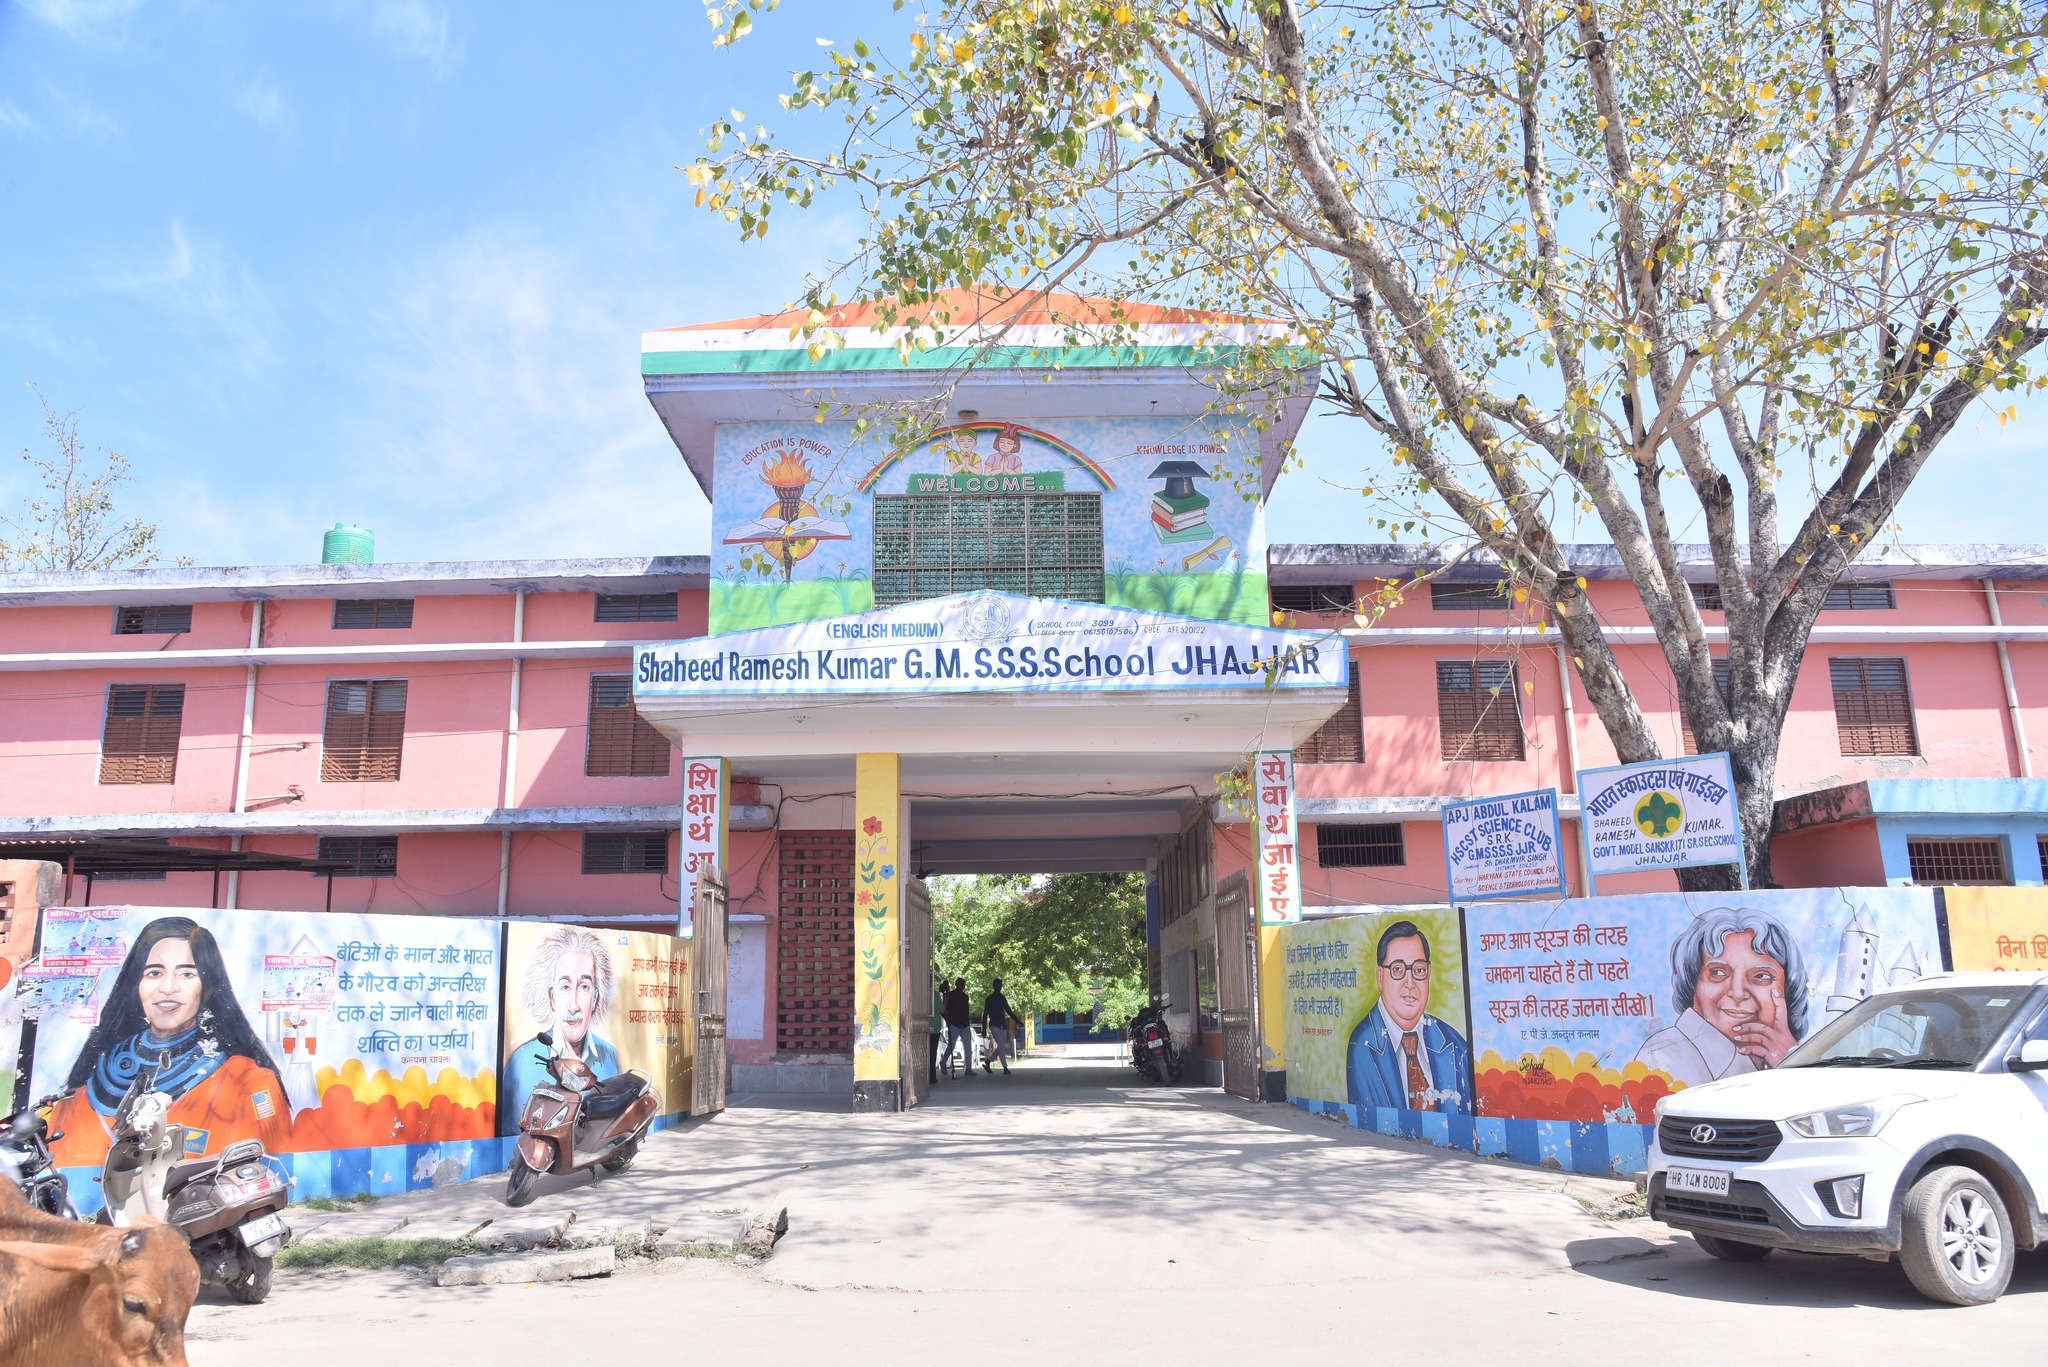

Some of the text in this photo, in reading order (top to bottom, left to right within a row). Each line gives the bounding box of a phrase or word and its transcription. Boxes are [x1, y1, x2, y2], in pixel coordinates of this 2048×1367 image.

[741, 437, 832, 465] EDUCATION IS POWER
[1136, 444, 1186, 455] KNOWLEDGE
[1188, 444, 1196, 454] IS
[826, 618, 945, 641] (ENGLISH MEDIUM)
[638, 650, 724, 684] Shaheed
[729, 650, 810, 681] Ramesh
[818, 649, 898, 680] Kumar
[1171, 643, 1321, 676] JHAJJAR
[1586, 784, 1621, 817] भारत
[1615, 769, 1668, 798] स्काउट्स
[1668, 768, 1686, 790] एवं
[1447, 795, 1552, 825] APJ ABDUL KALAM
[1593, 816, 1632, 829] SHAHEED
[1450, 817, 1552, 866] HSCST SCIENCE CLUB
[1595, 829, 1637, 843] RAMESH
[1494, 855, 1526, 866] DHARMVIR
[1528, 852, 1548, 863] SINGH
[1593, 845, 1619, 859] GOVT.
[1619, 843, 1645, 856] MODEL
[1645, 838, 1686, 854] SANSKRITI
[1635, 852, 1689, 866] JHAJJAR
[1478, 872, 1503, 882] HARYANA
[1504, 868, 1523, 879] STATE
[1523, 867, 1545, 877] COUNCIL
[1545, 865, 1556, 874] FOR
[1477, 882, 1498, 892] SCIENCE
[1480, 923, 1629, 953] अगर आप सूरज की तरह
[1995, 935, 2027, 959] बिना
[384, 943, 399, 963] के
[404, 947, 437, 964] मान
[437, 944, 461, 965] और
[463, 948, 494, 965] भारत
[1334, 940, 1349, 960] लिए
[631, 958, 645, 973] आप
[1484, 957, 1630, 985] चमकना चाहते हैं तो पहले
[338, 970, 488, 994] के गौरव को अन्तरिक्ष
[1321, 968, 1329, 990] ही
[1329, 967, 1358, 990] महिलाओं
[638, 984, 649, 998] जब
[336, 1004, 366, 1022] तक
[369, 1000, 386, 1022] ले
[390, 1001, 424, 1022] जाने
[426, 1000, 454, 1021] वाली
[456, 1000, 489, 1022] महिला
[629, 1009, 648, 1024] प्रयास
[1488, 999, 1521, 1024] सूरज
[1522, 994, 1539, 1018] की
[1539, 998, 1570, 1020] तरह
[1571, 997, 1610, 1018] जलना
[356, 1029, 402, 1054] शक्ति
[404, 1035, 424, 1053] का
[1576, 1029, 1600, 1040] कलाम
[400, 1055, 451, 1064] कल्पना चावला
[1519, 1057, 1545, 1076] Sehgal
[1672, 1171, 1682, 1186] HR
[1702, 1175, 1727, 1191] 8008
